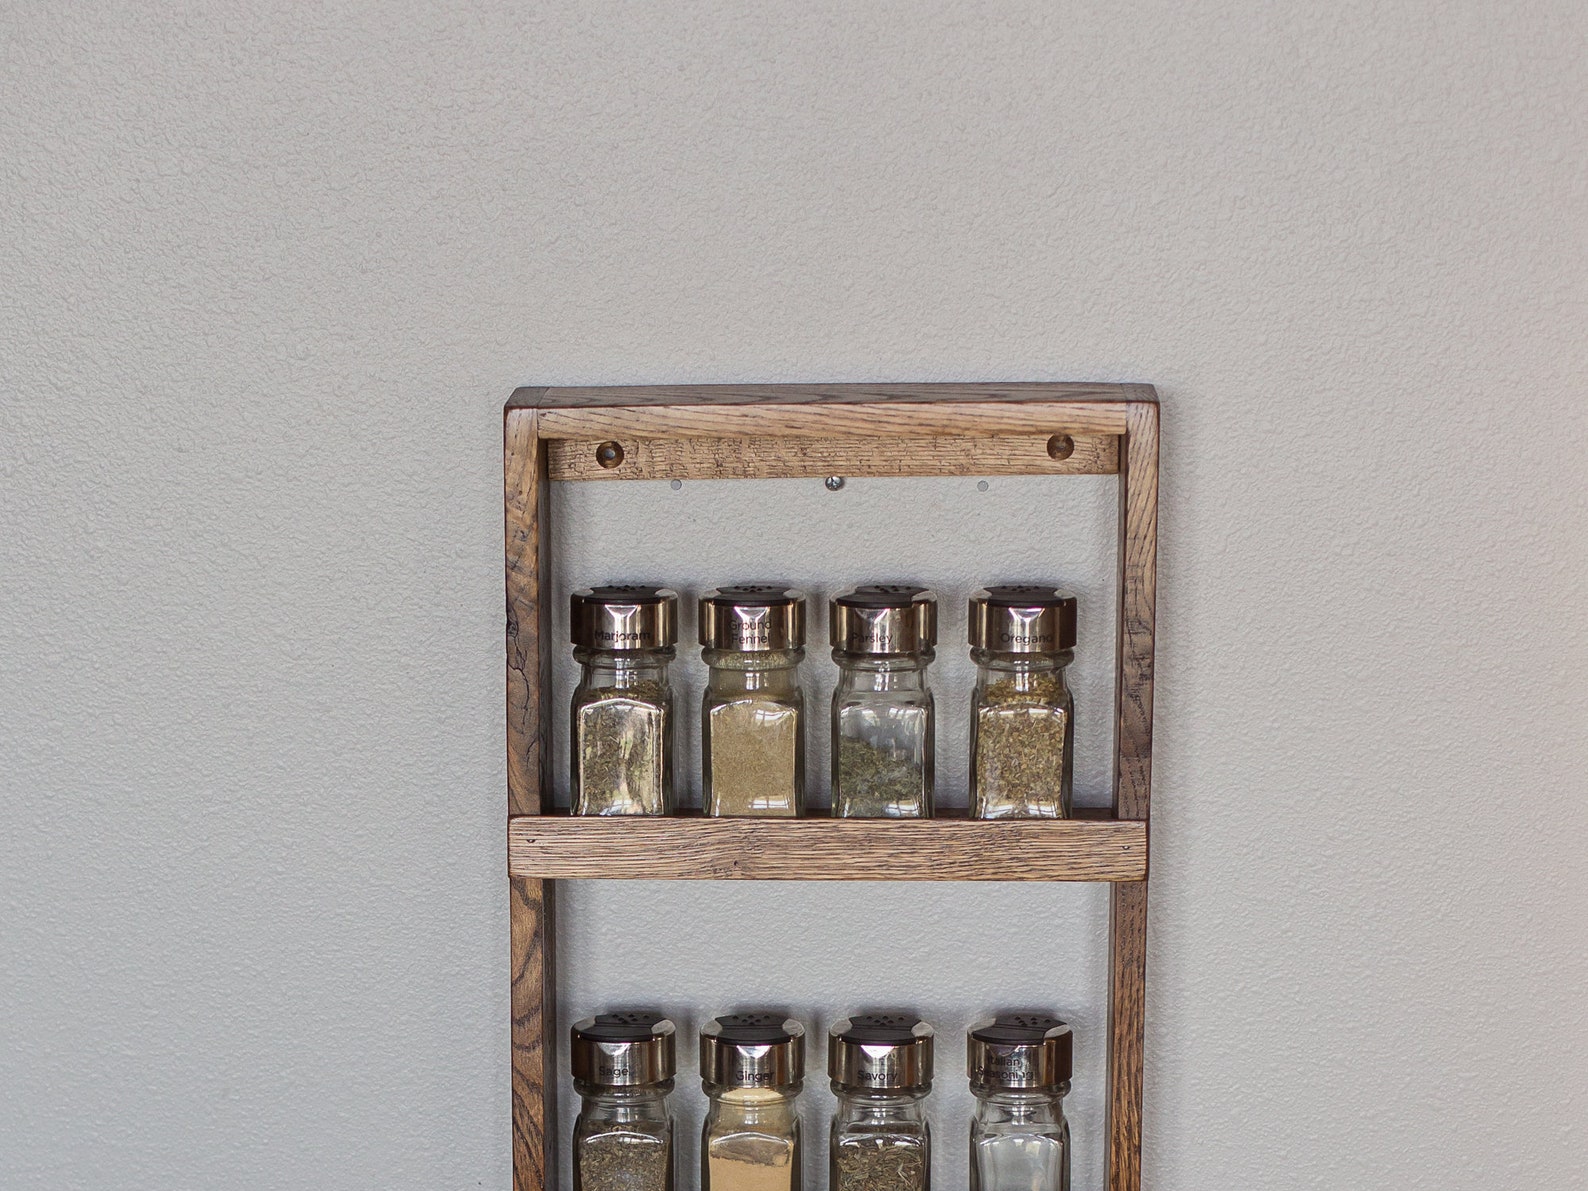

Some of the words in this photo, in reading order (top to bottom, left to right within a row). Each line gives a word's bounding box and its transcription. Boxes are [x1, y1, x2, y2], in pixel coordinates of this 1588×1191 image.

[729, 618, 772, 631] Ground
[594, 630, 651, 643] Marjoram
[731, 632, 769, 645] Fennel
[851, 631, 893, 644] Parsley
[1000, 632, 1053, 646] Oregano
[987, 1056, 1020, 1068] Italian
[598, 1065, 628, 1078] Sage
[735, 1070, 774, 1082] Ginger
[857, 1069, 898, 1082] Savory
